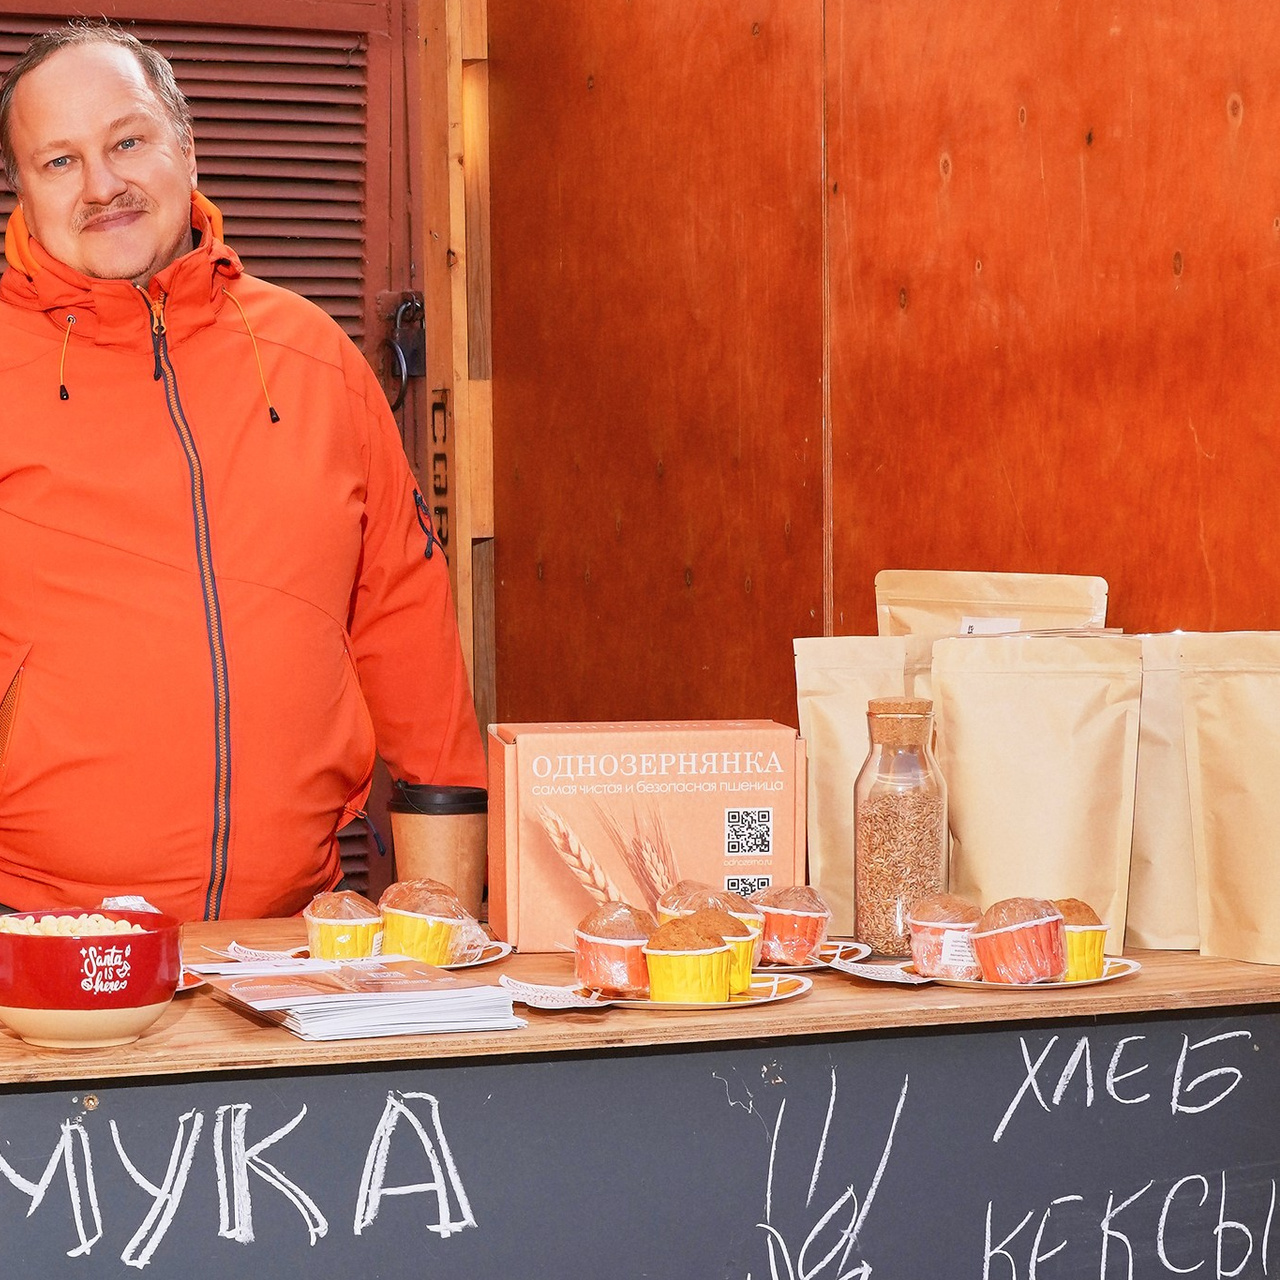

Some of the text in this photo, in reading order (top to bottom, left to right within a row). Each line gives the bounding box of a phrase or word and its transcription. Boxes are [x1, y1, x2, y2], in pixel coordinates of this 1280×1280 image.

[531, 751, 785, 782] ОДНОЗЕРНЯНКА
[531, 780, 784, 796] самая чистая и безопасная пшеница
[84, 945, 123, 978] Santa
[992, 1030, 1253, 1143] ХЛЕБ
